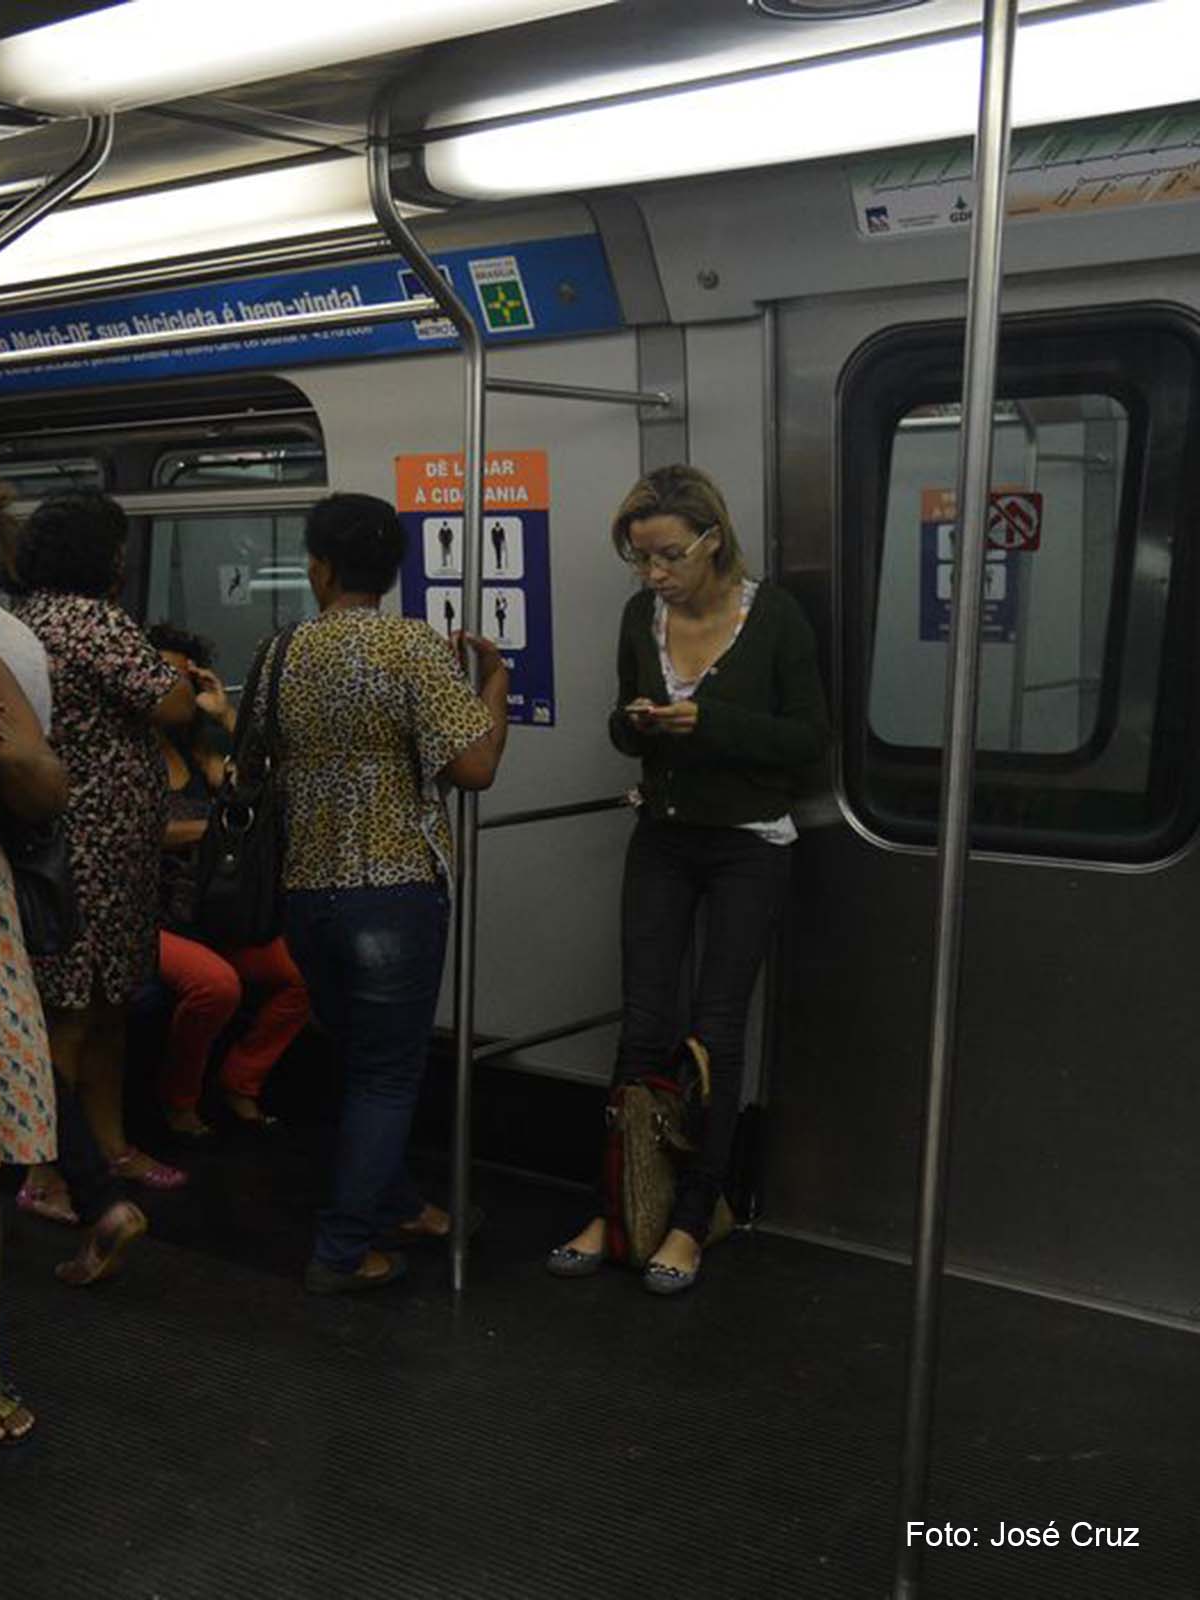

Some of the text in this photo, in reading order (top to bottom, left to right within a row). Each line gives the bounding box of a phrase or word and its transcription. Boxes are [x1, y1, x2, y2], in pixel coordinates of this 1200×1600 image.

[96, 321, 131, 340] sua
[133, 307, 218, 334] bicicleta
[222, 302, 236, 323] é
[454, 459, 515, 477] LAR
[431, 485, 529, 504] CIDANIA
